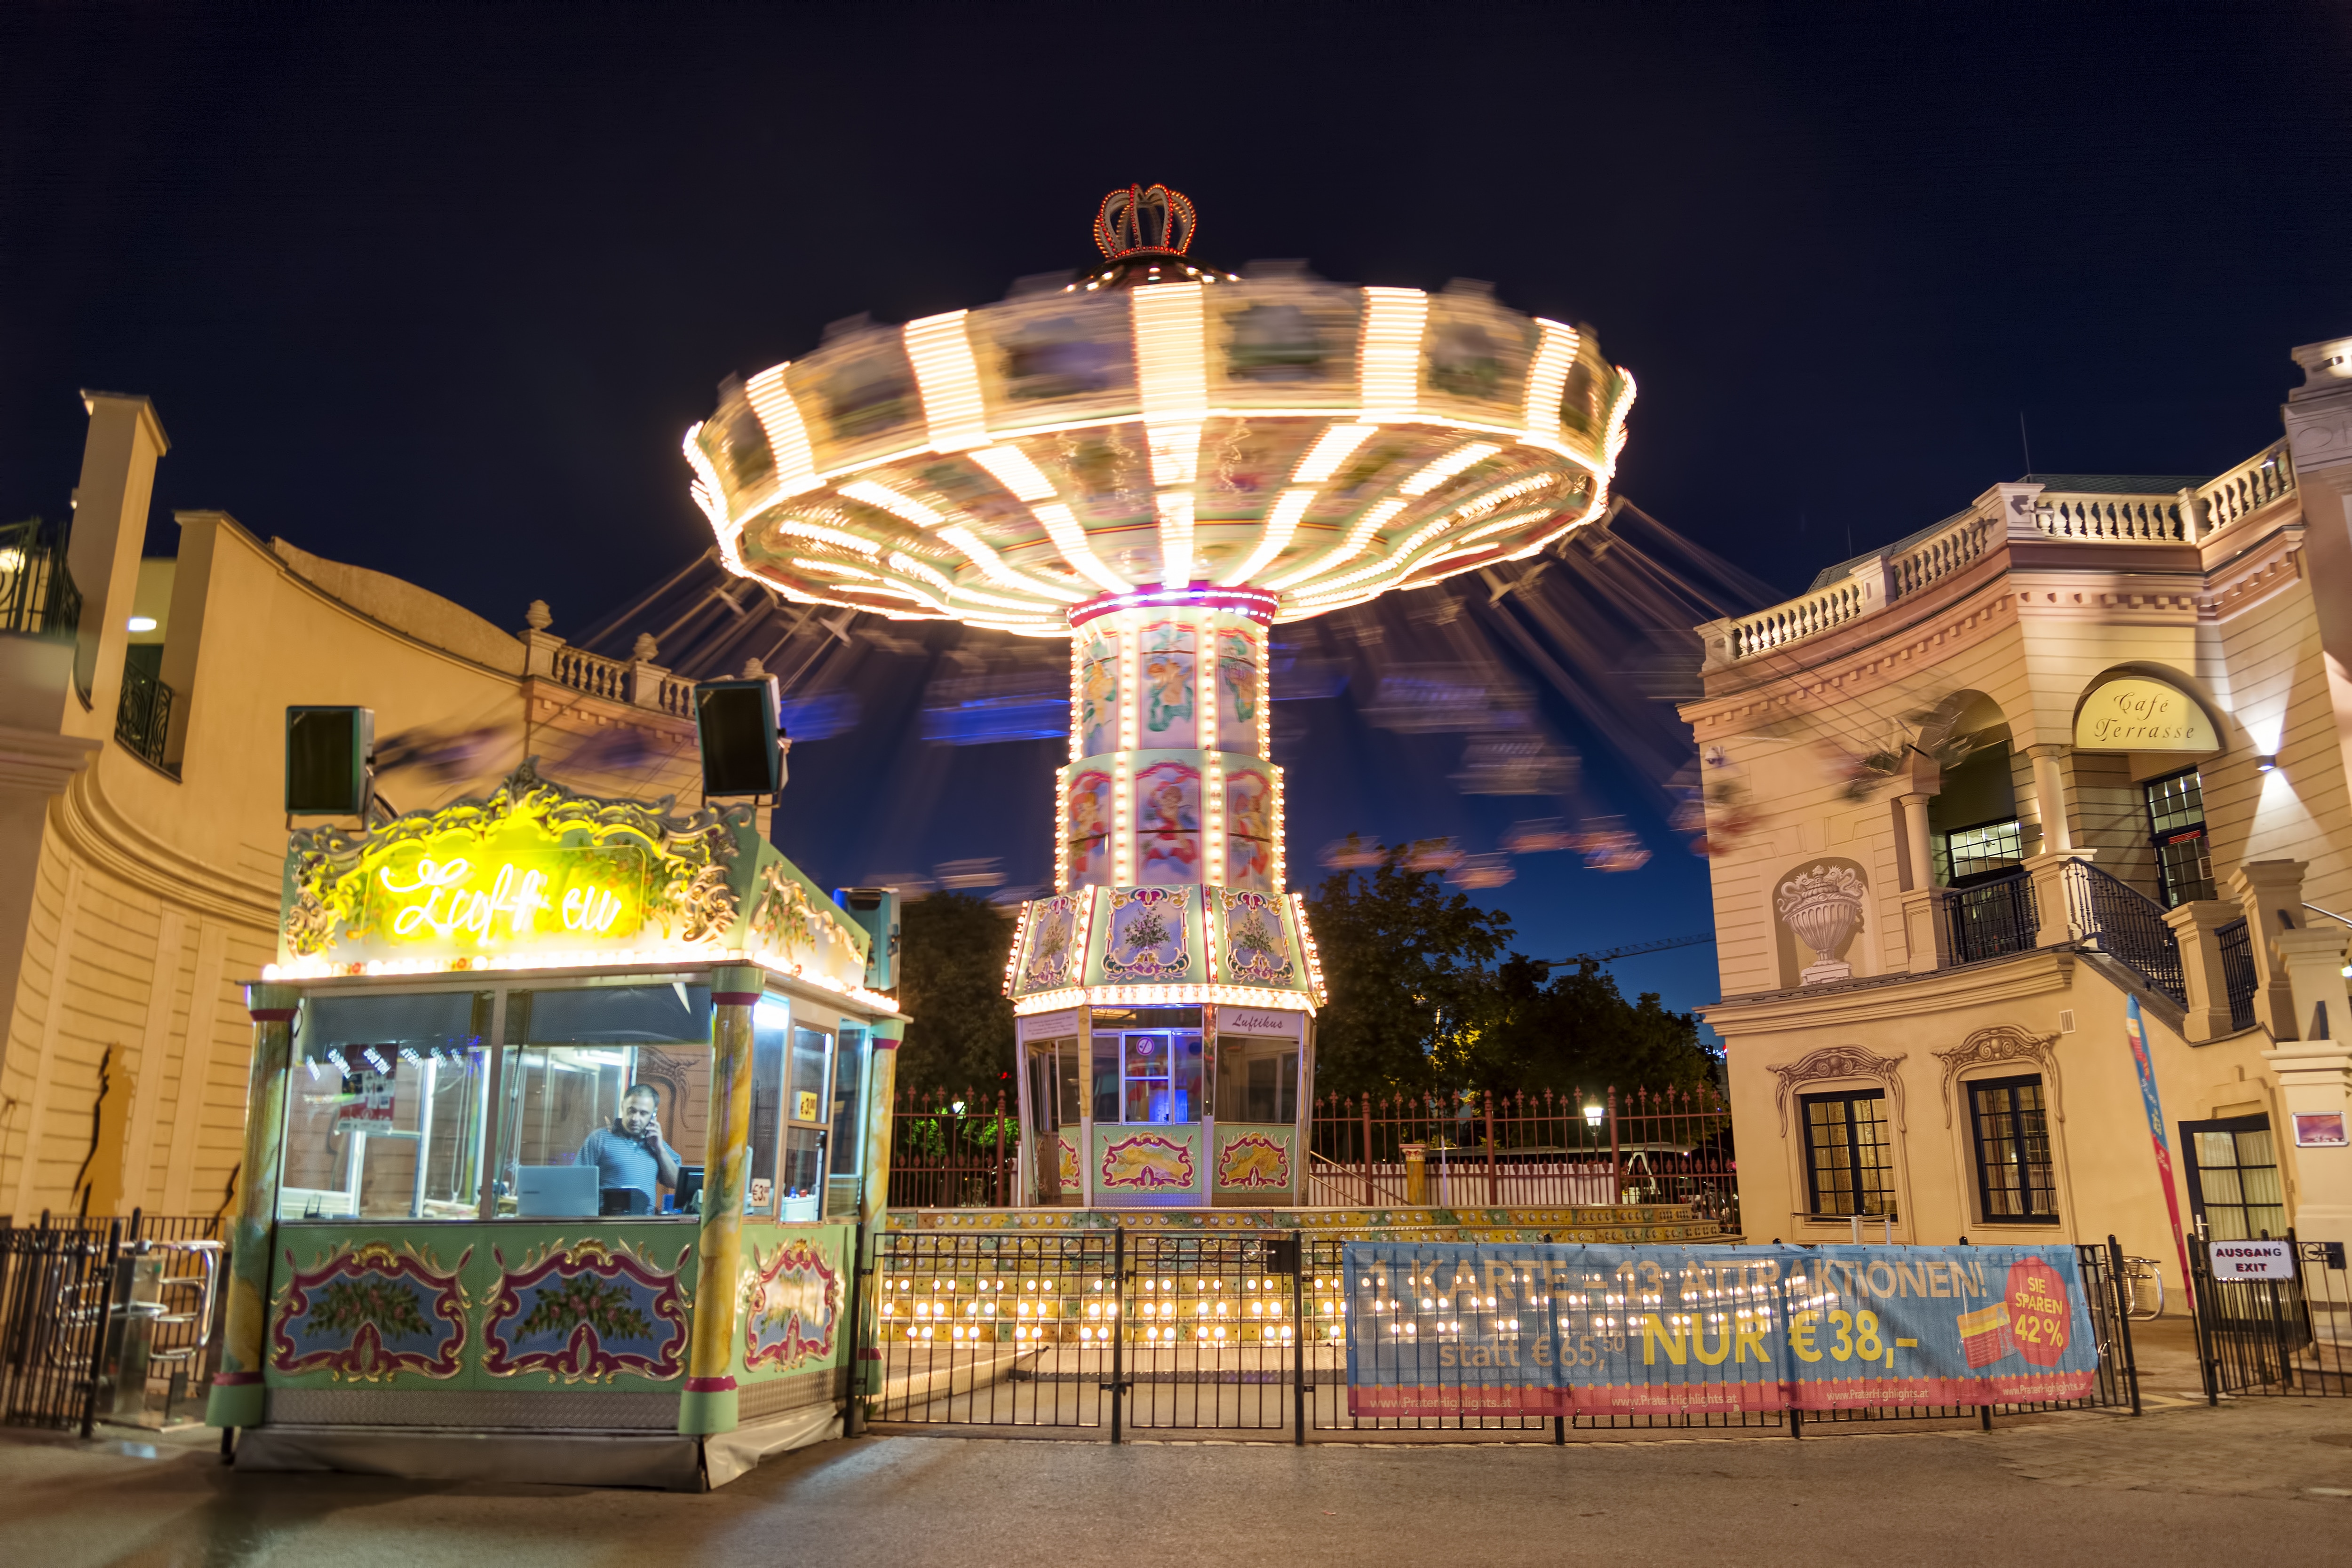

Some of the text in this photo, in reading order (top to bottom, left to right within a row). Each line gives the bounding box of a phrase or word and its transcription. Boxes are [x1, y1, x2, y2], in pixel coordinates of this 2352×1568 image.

[2114, 692, 2169, 721] Café
[2094, 718, 2194, 741] Terrasse
[1232, 1013, 1283, 1032] Luftikus
[2216, 1248, 2281, 1258] AUSGANG
[2235, 1263, 2267, 1272] EXIT
[1367, 1259, 1388, 1299] 1
[1411, 1259, 1570, 1299] KARTE
[1616, 1260, 1664, 1299] 13
[1678, 1259, 1987, 1298] ATTRAKTIONEN!
[2027, 1276, 2046, 1294] SIE
[2015, 1292, 2063, 1315] SPAREN
[1642, 1312, 1771, 1366] NUR
[1439, 1339, 1520, 1367] statt
[1370, 1396, 1512, 1410] www.PraterHighlights.at
[1612, 1394, 1737, 1408] www.PraterHighlights.at
[1827, 1387, 1929, 1402] www.PraterHighlights.at
